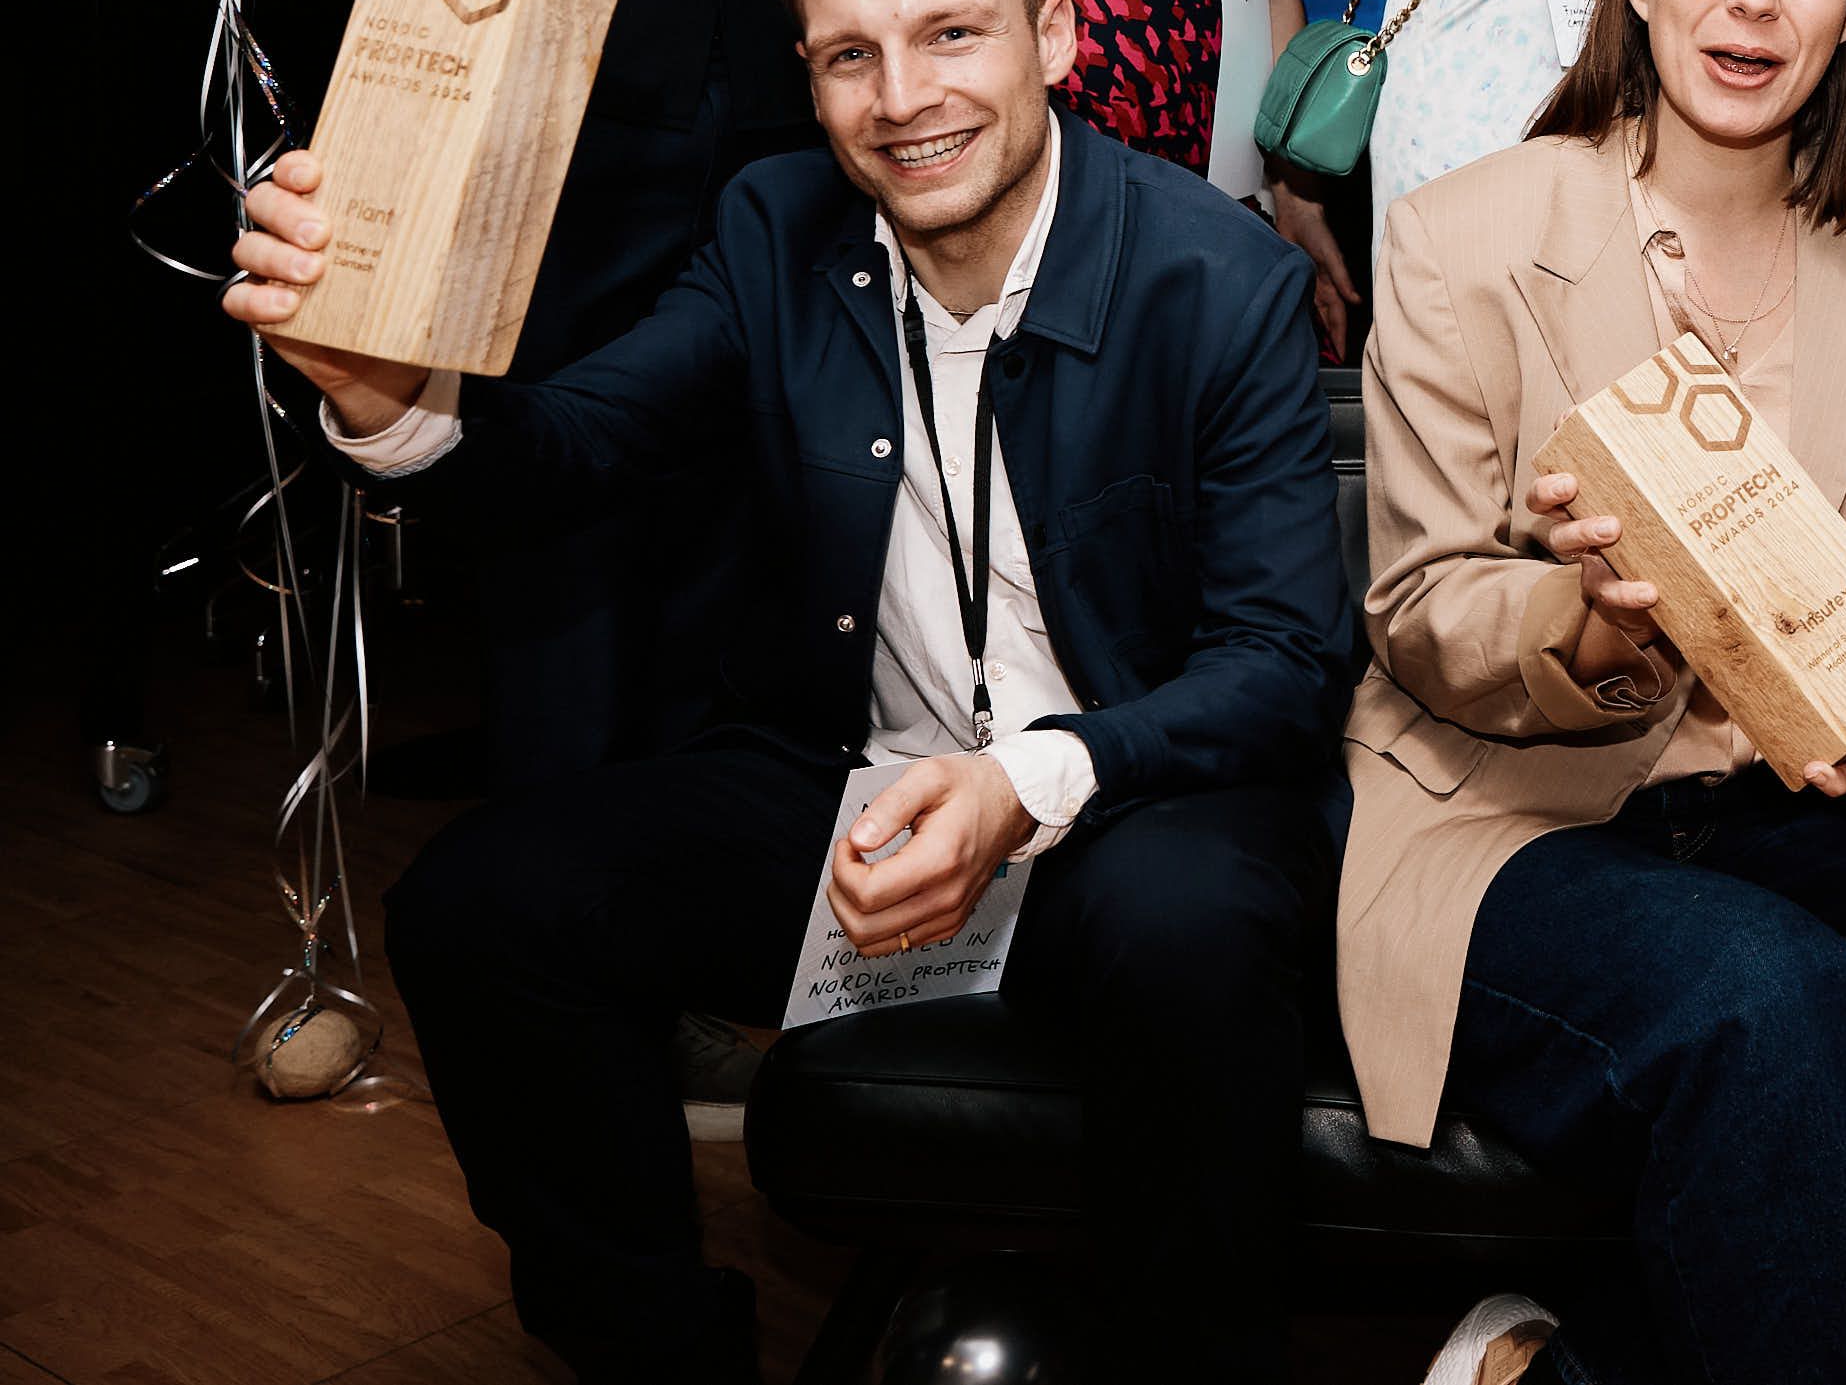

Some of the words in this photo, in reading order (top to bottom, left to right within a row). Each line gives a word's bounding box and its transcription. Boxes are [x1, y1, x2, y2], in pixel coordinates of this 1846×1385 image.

[366, 16, 430, 38] NORDIC
[354, 36, 473, 79] PROPTECH
[350, 71, 422, 93] AWARDS
[430, 84, 473, 102] 2024
[346, 199, 395, 226] Plant
[1677, 475, 1728, 517] NORDIC
[1688, 463, 1782, 537] PROPTECH
[1710, 507, 1765, 553] AWARDS
[1767, 480, 1799, 509] 2024
[1807, 646, 1833, 670] Winner
[966, 928, 995, 947] IN
[808, 971, 899, 999] NORDIC
[912, 958, 1001, 982] PROPTECH
[828, 984, 920, 1014] AWARDS
